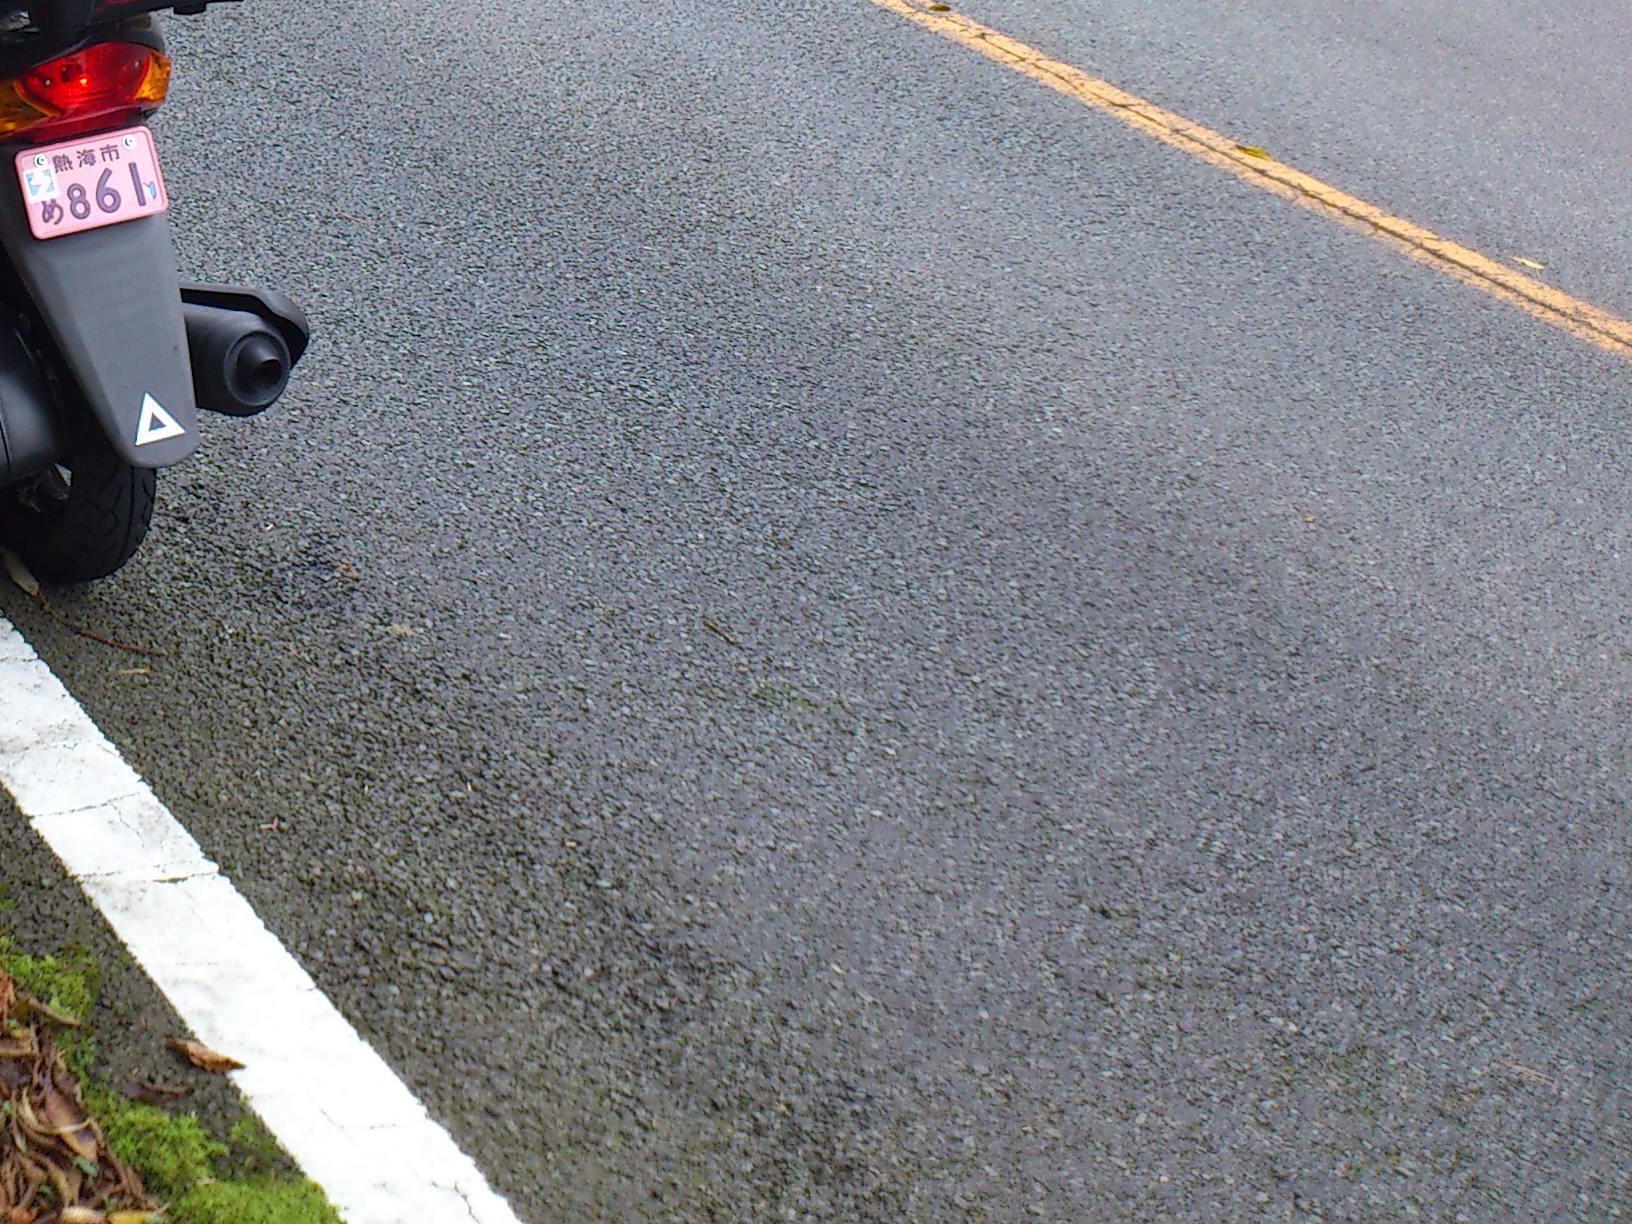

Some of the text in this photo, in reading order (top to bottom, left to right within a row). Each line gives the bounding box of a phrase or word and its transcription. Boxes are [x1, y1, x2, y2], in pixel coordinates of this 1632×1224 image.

[52, 144, 121, 173] 熱海市
[41, 162, 147, 226] め 861
